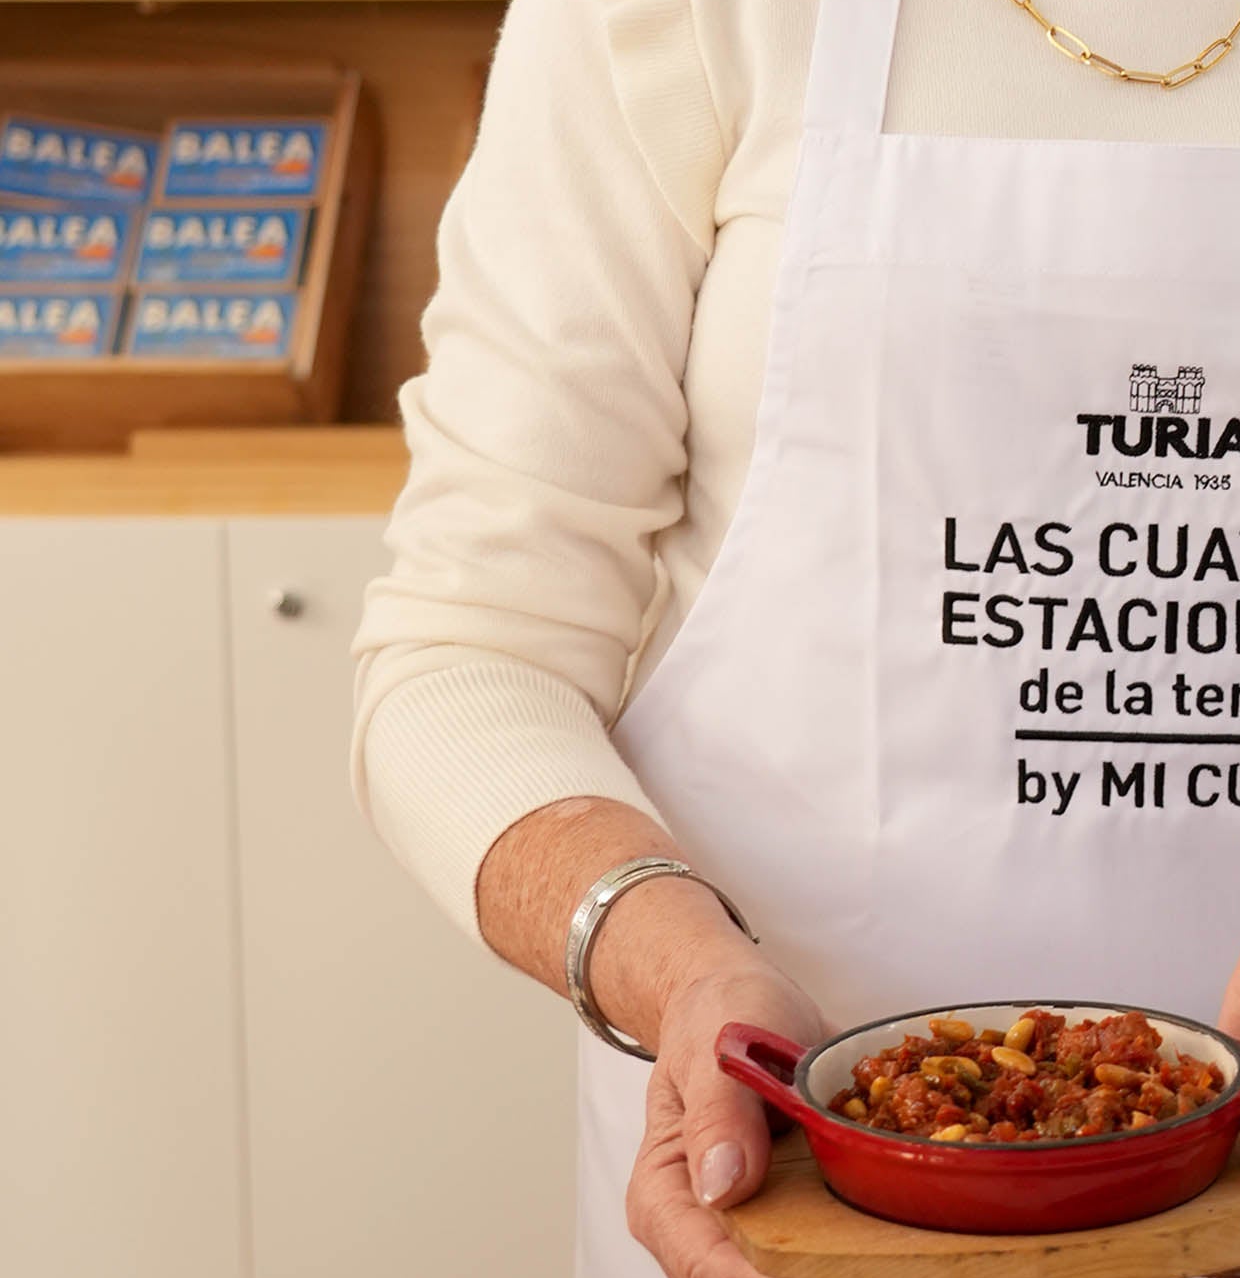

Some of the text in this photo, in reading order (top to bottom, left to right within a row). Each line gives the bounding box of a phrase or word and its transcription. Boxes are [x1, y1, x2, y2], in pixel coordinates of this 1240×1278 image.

[0, 215, 117, 250] ALEA
[1095, 471, 1183, 489] VALENCIA
[944, 518, 1074, 576] LAS
[1019, 668, 1083, 714] de
[1105, 669, 1153, 716] la
[1016, 758, 1080, 816] by
[1102, 762, 1166, 808] MI
